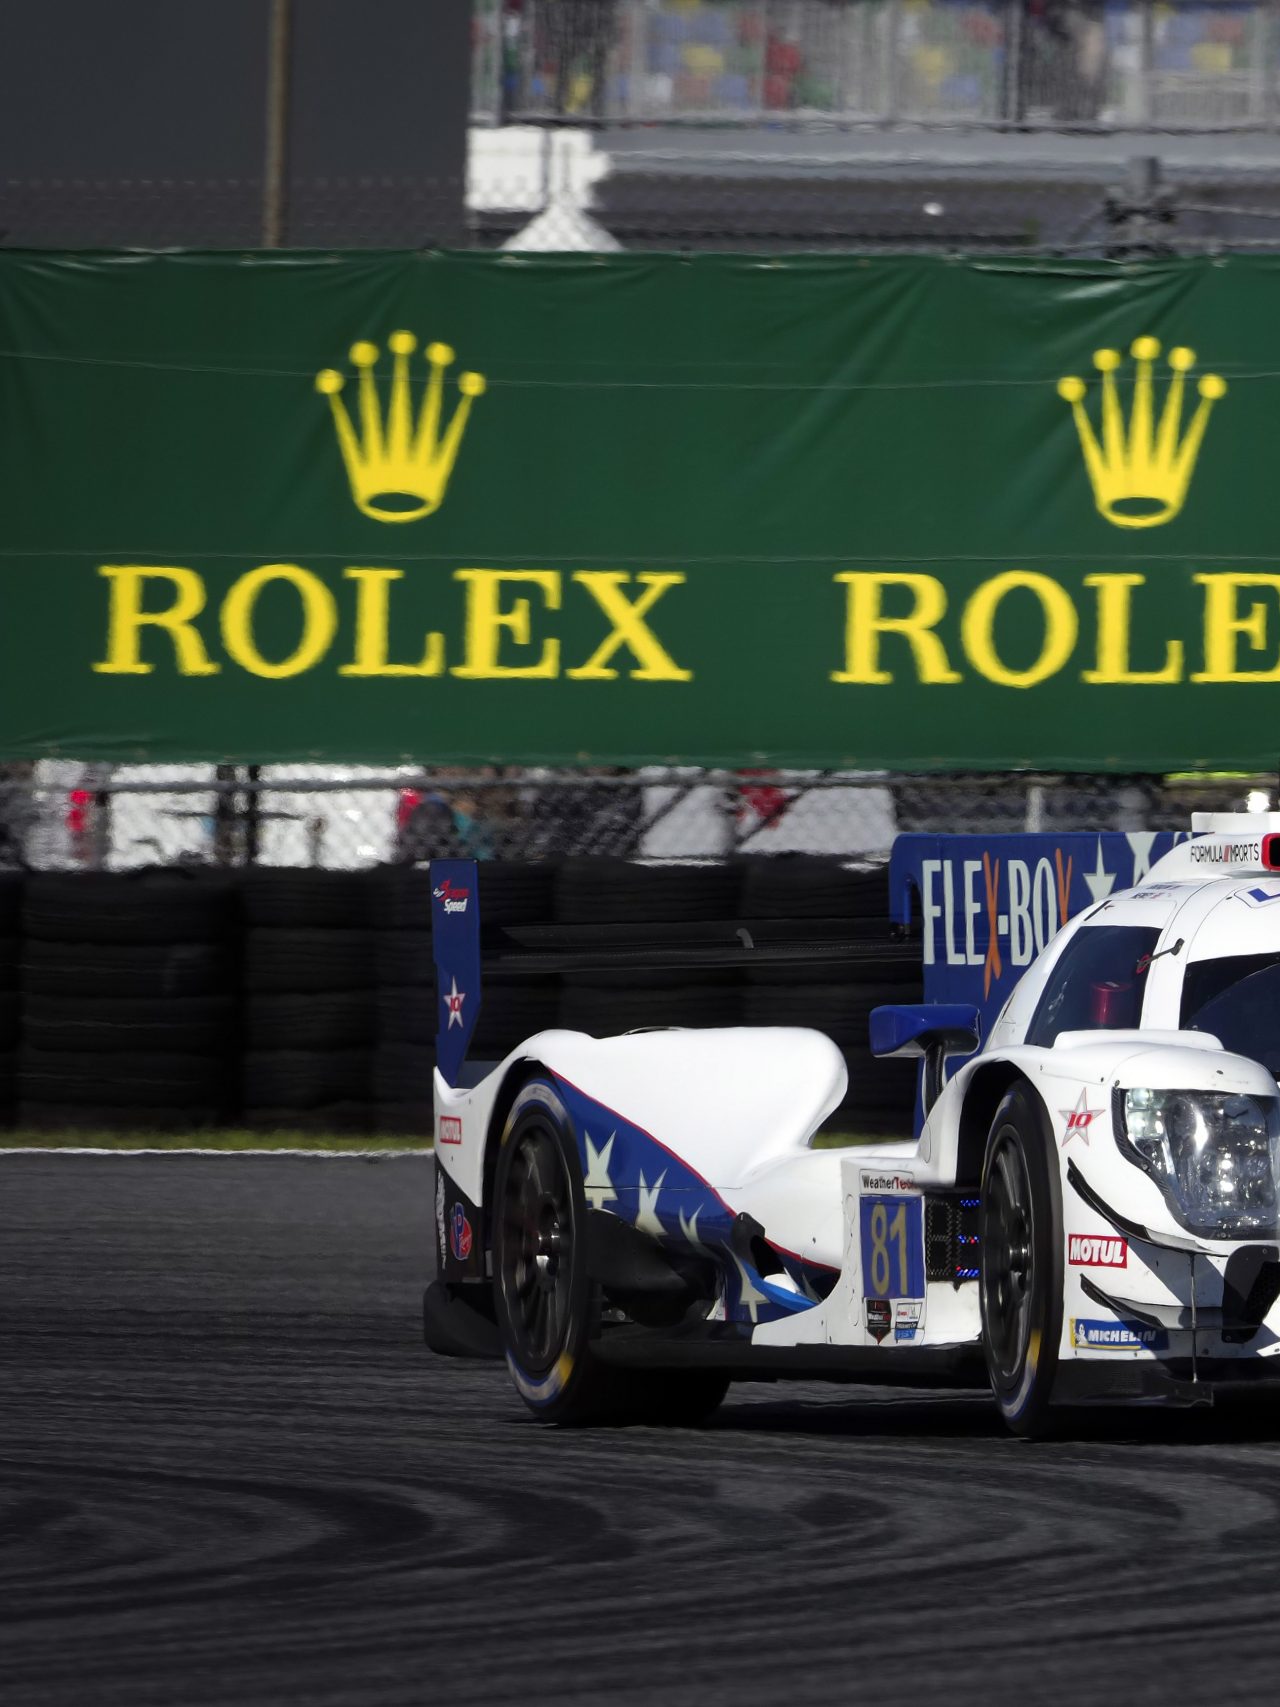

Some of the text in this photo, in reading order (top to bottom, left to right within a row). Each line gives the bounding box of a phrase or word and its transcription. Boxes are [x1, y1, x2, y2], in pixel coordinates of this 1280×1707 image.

[92, 564, 694, 680] ROLEX
[1067, 1112, 1093, 1129] 10
[871, 1201, 908, 1296] 81
[1070, 1237, 1124, 1264] MOTUL
[1088, 1329, 1157, 1342] MICHELIN
